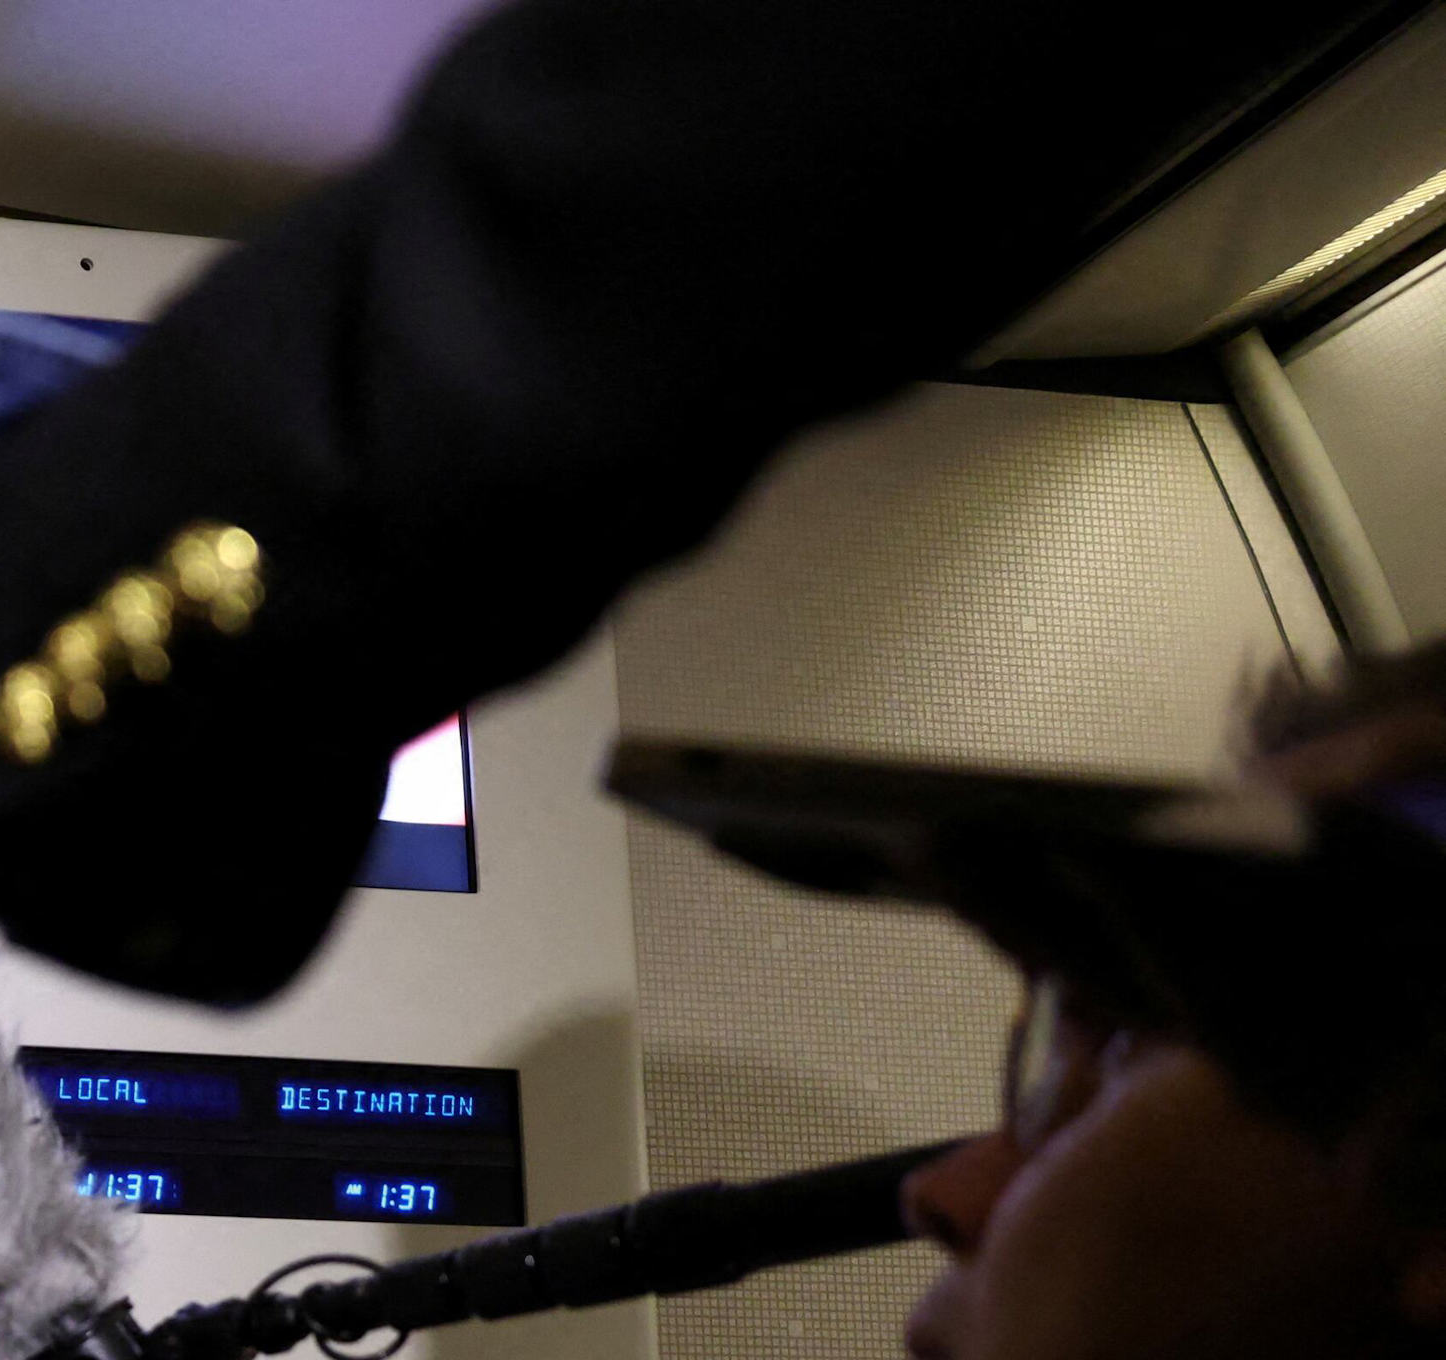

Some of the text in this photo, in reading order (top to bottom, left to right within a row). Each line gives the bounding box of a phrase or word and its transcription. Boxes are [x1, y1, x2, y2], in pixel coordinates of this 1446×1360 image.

[59, 1077, 149, 1105] LOCAL
[280, 1085, 475, 1118] DESTINATION
[345, 1183, 437, 1211] AM 1:37
